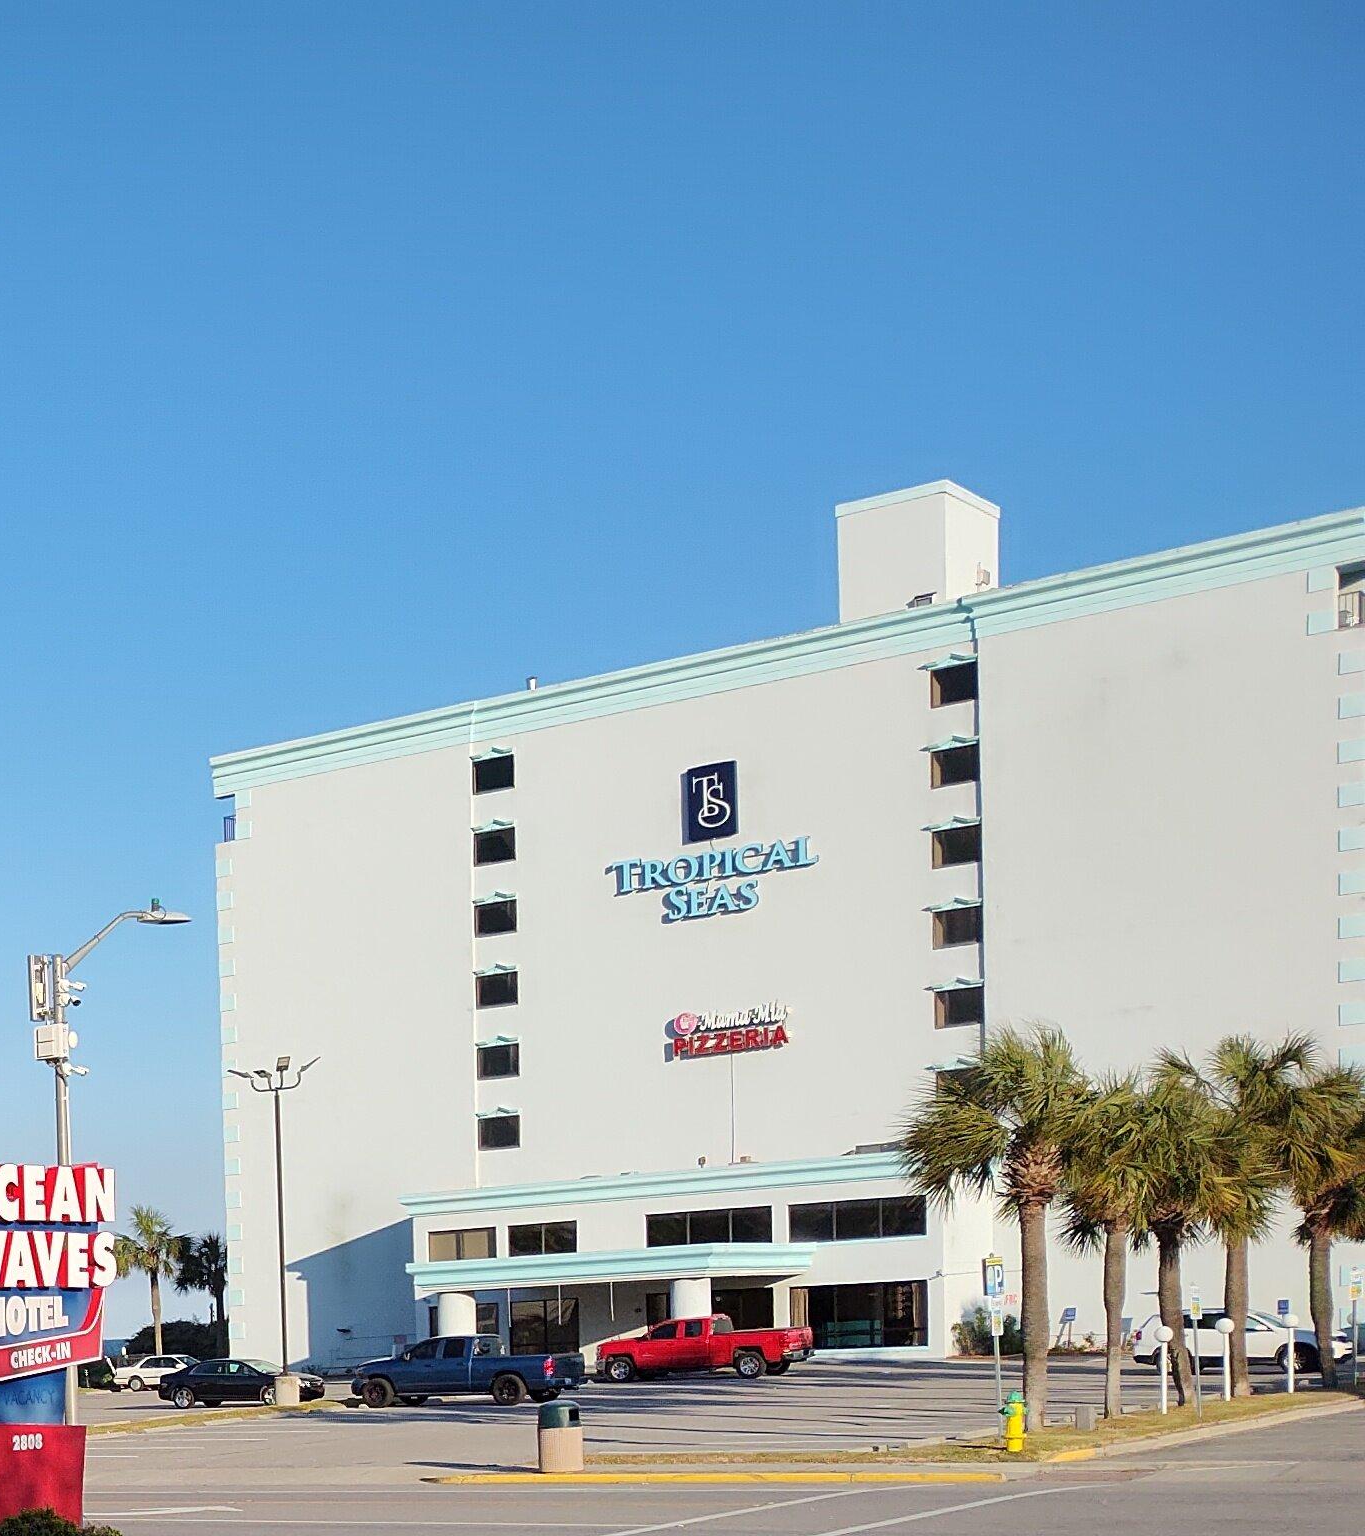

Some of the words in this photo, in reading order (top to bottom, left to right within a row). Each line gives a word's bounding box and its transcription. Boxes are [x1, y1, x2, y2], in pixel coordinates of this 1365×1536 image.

[611, 835, 819, 893] TROPICAL
[668, 879, 760, 921] SEAS
[673, 1024, 789, 1056] PIZZERIA
[10, 1341, 72, 1369] CHECK-IN
[3, 1388, 56, 1406] VACANCY
[12, 1433, 43, 1451] 2808
